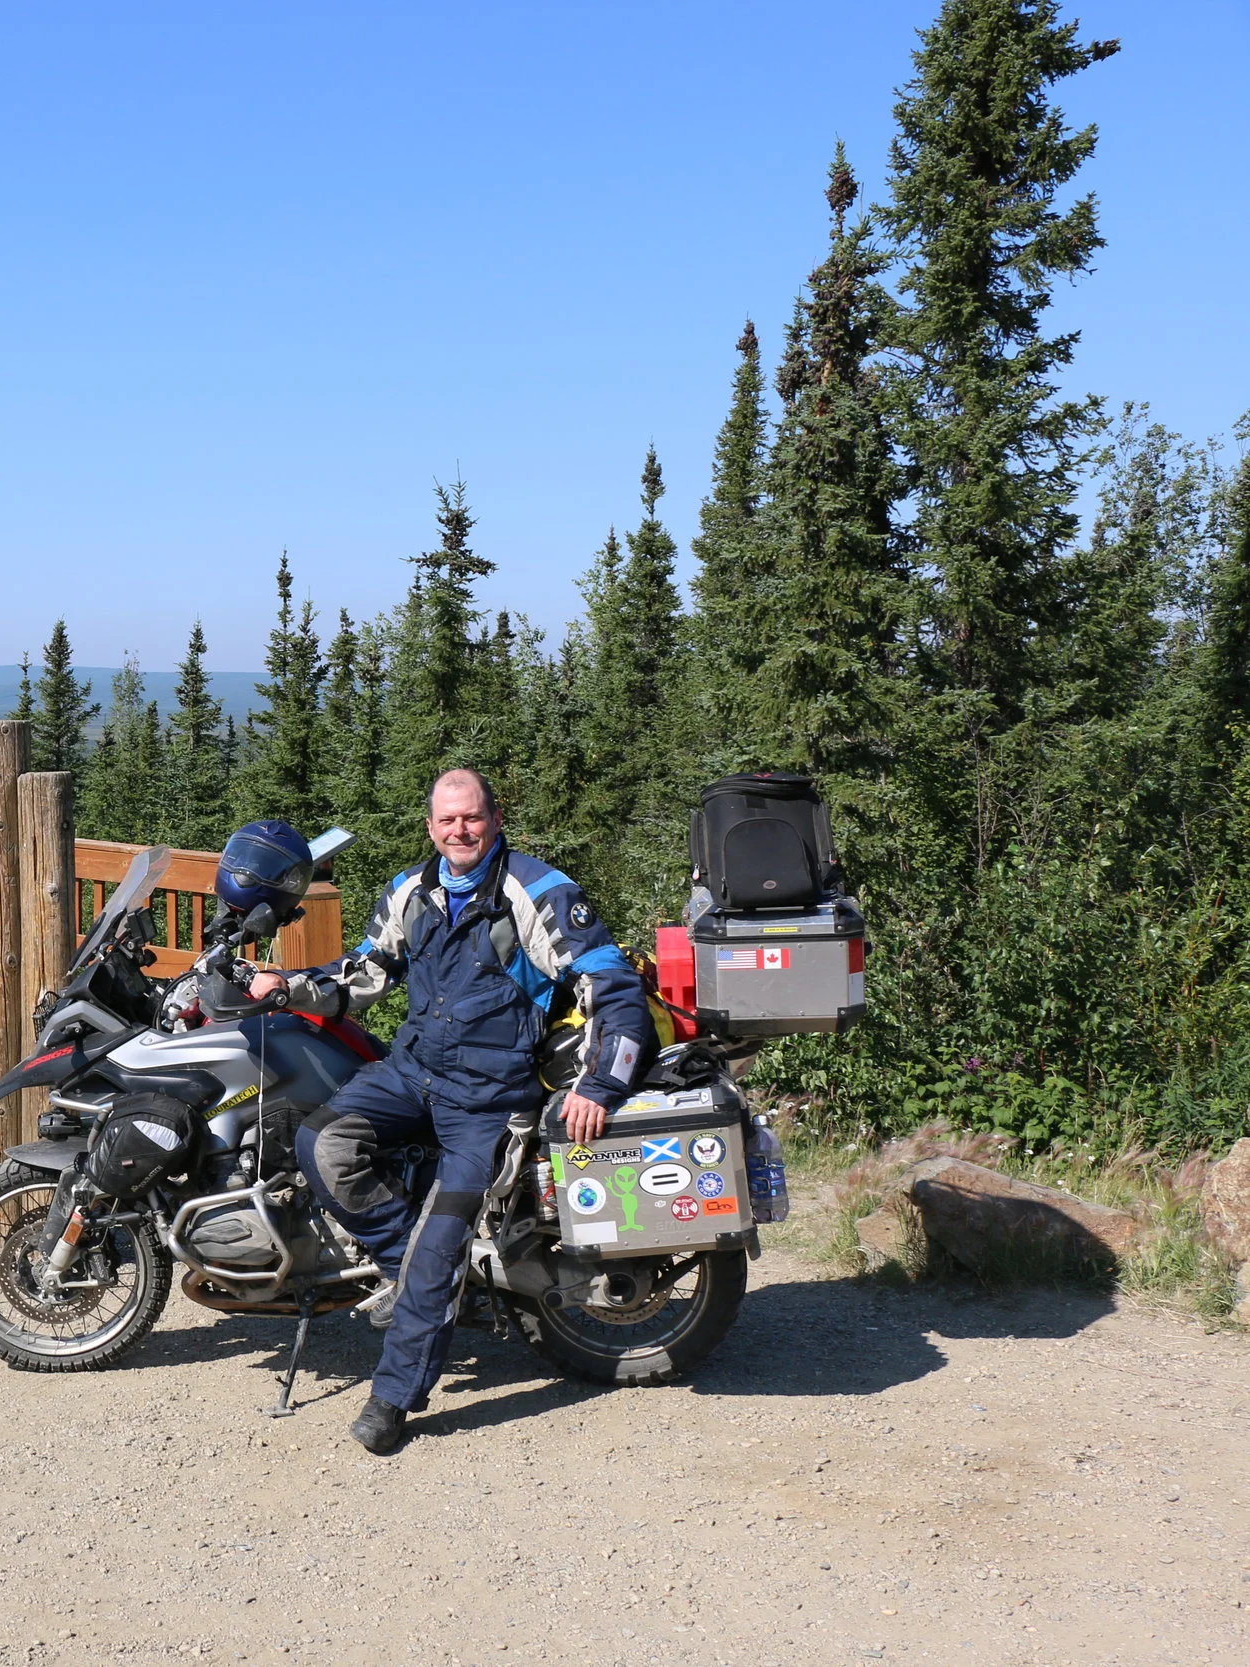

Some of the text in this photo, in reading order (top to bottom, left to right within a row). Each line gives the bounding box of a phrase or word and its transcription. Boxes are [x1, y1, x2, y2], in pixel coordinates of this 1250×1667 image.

[204, 1086, 257, 1119] TOURATECH
[571, 1149, 640, 1162] ADVENTURE
[611, 1157, 641, 1165] DESIGNS
[699, 1173, 720, 1181] SEAT
